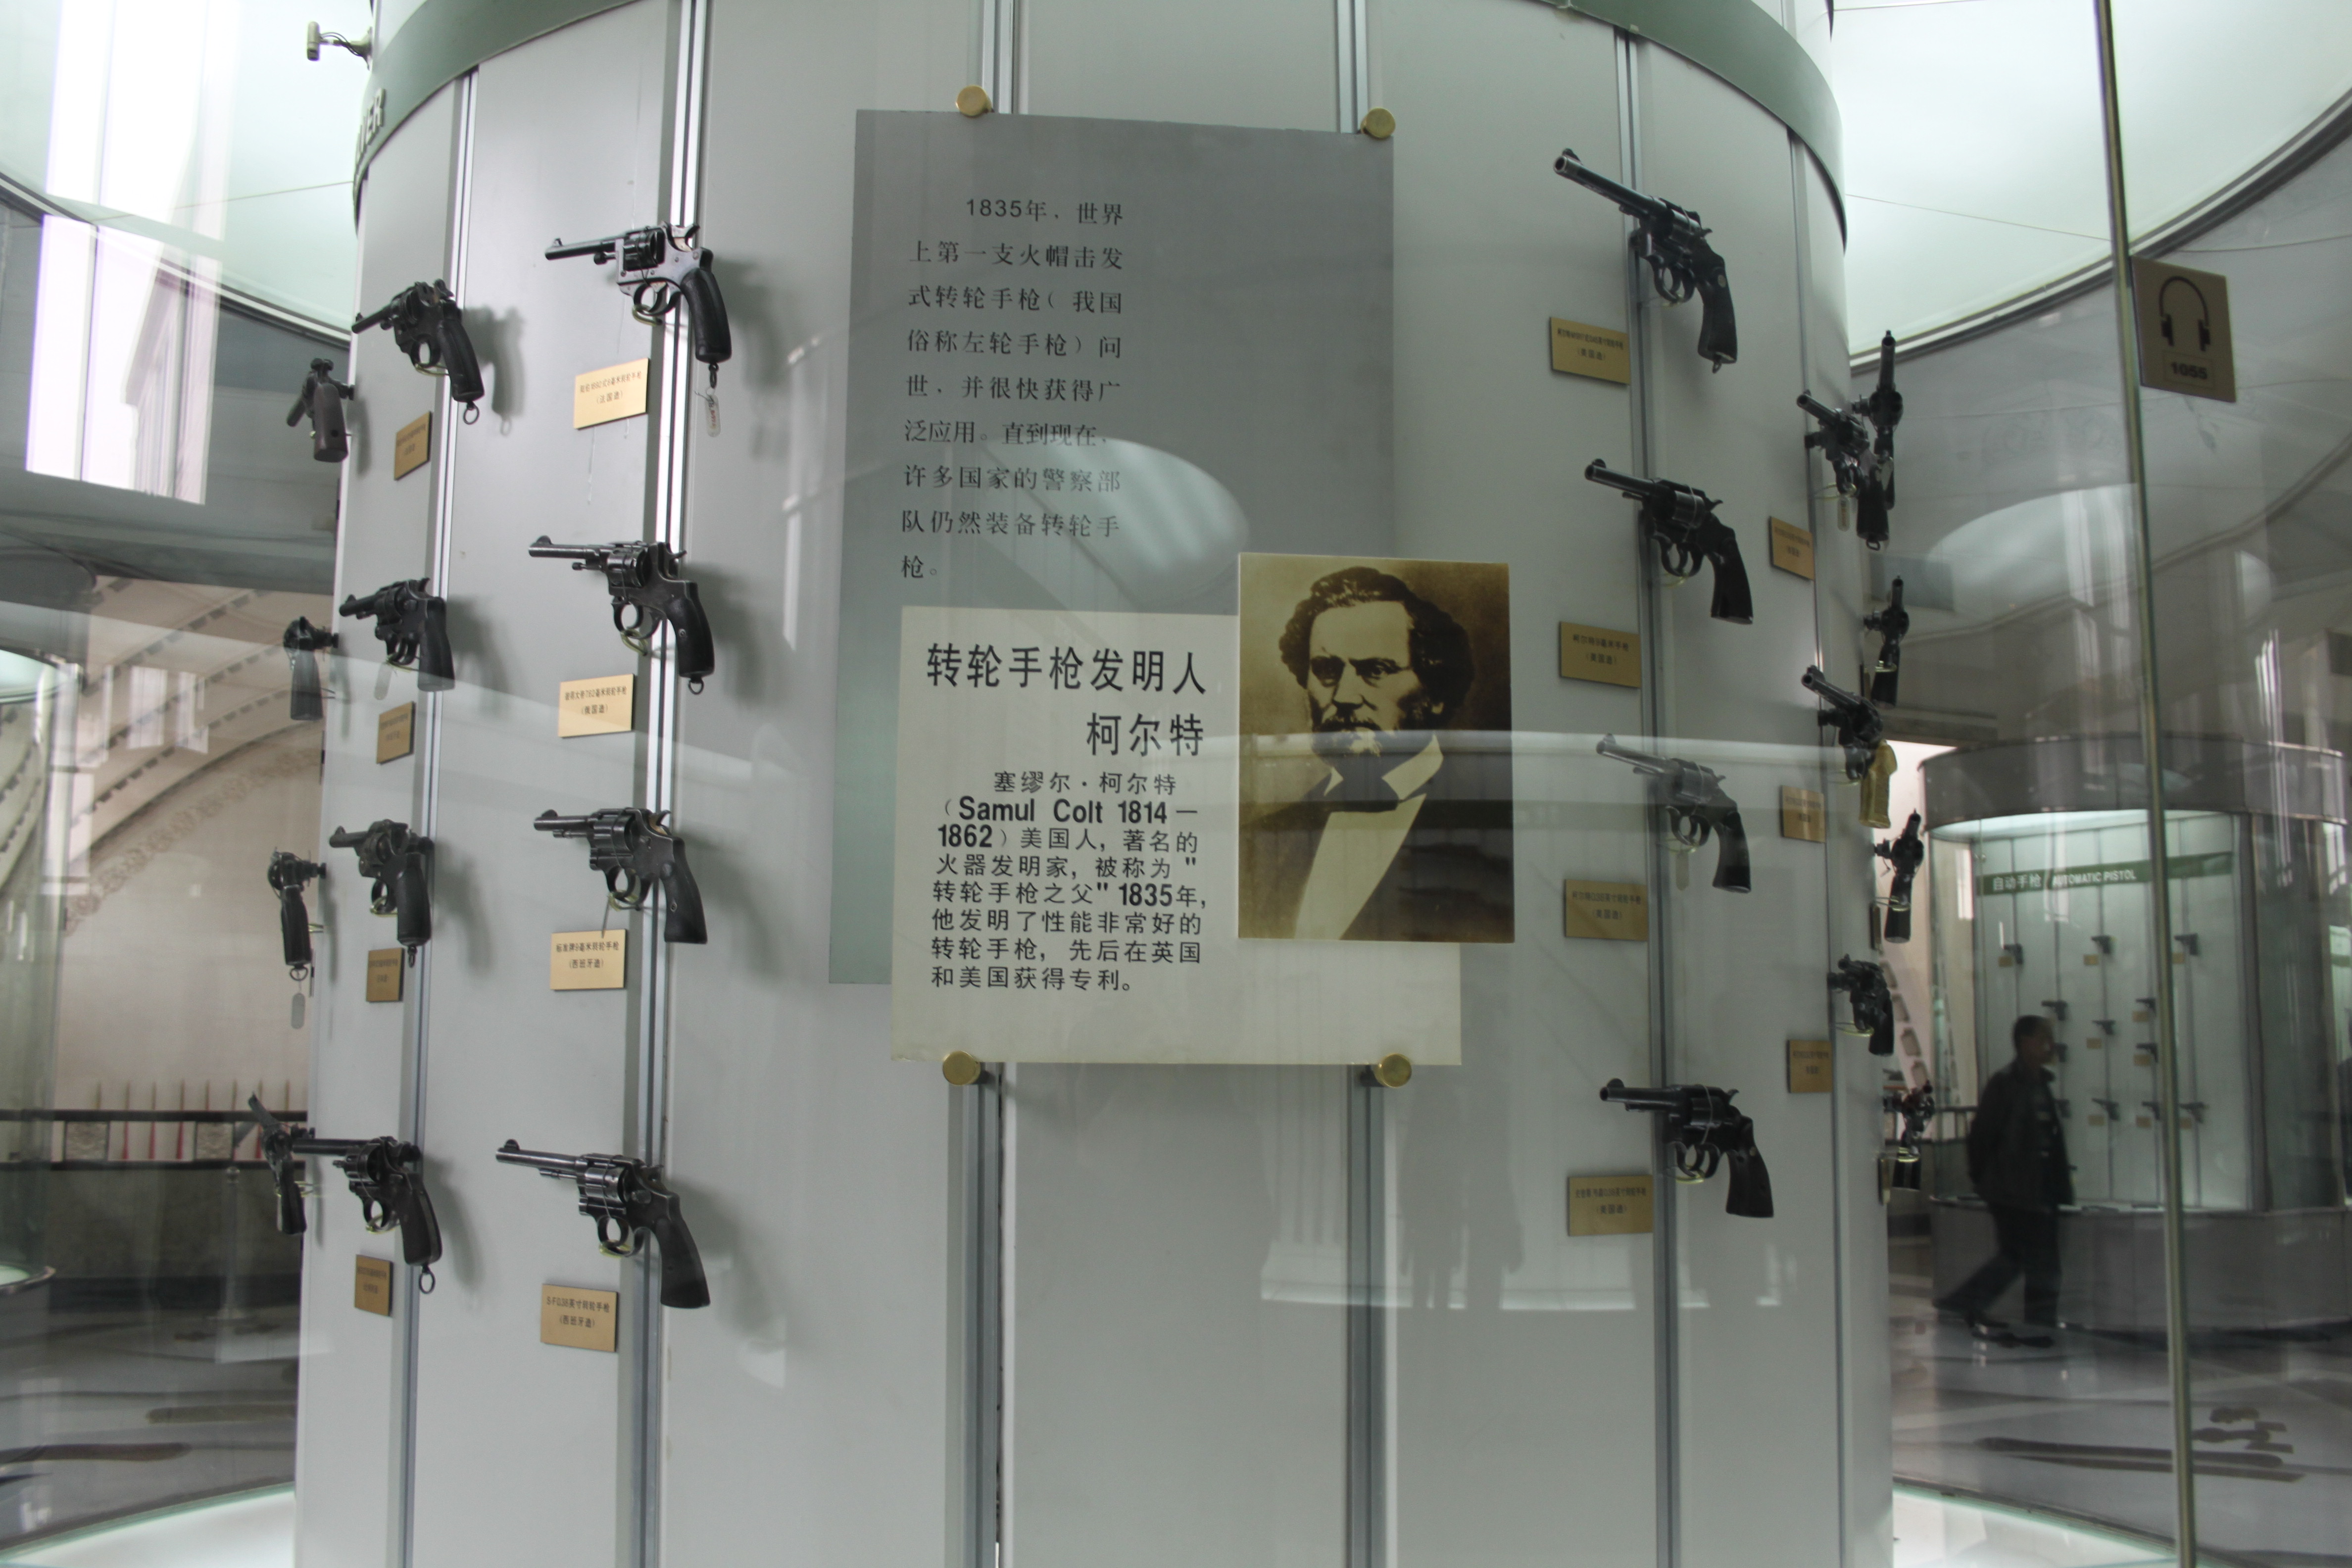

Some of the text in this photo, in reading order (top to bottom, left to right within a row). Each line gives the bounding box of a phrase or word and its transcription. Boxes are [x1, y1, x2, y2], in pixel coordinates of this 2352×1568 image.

[909, 241, 1124, 270] 上第一支火帽击发
[908, 285, 1123, 314] 式转轮手枪（我国
[907, 330, 1122, 359] 俗称左轮手枪）问
[904, 465, 1121, 492] 许多国家的警察部
[902, 510, 1120, 538] 队仍然装备转轮手
[901, 555, 937, 580] 枪。
[927, 643, 1206, 694] 转轮手枪发明人
[1086, 713, 1204, 756] 柯尔特
[1054, 799, 1103, 824] Colt
[1993, 873, 2042, 891] 自动手枪
[2052, 870, 2137, 887] AUTOMATIC PISTOL
[932, 909, 1201, 935] 他发明了性能非常好的
[931, 937, 1201, 963] 转轮手枪，先后在英国
[931, 966, 1131, 991] 和美国获得专利。
